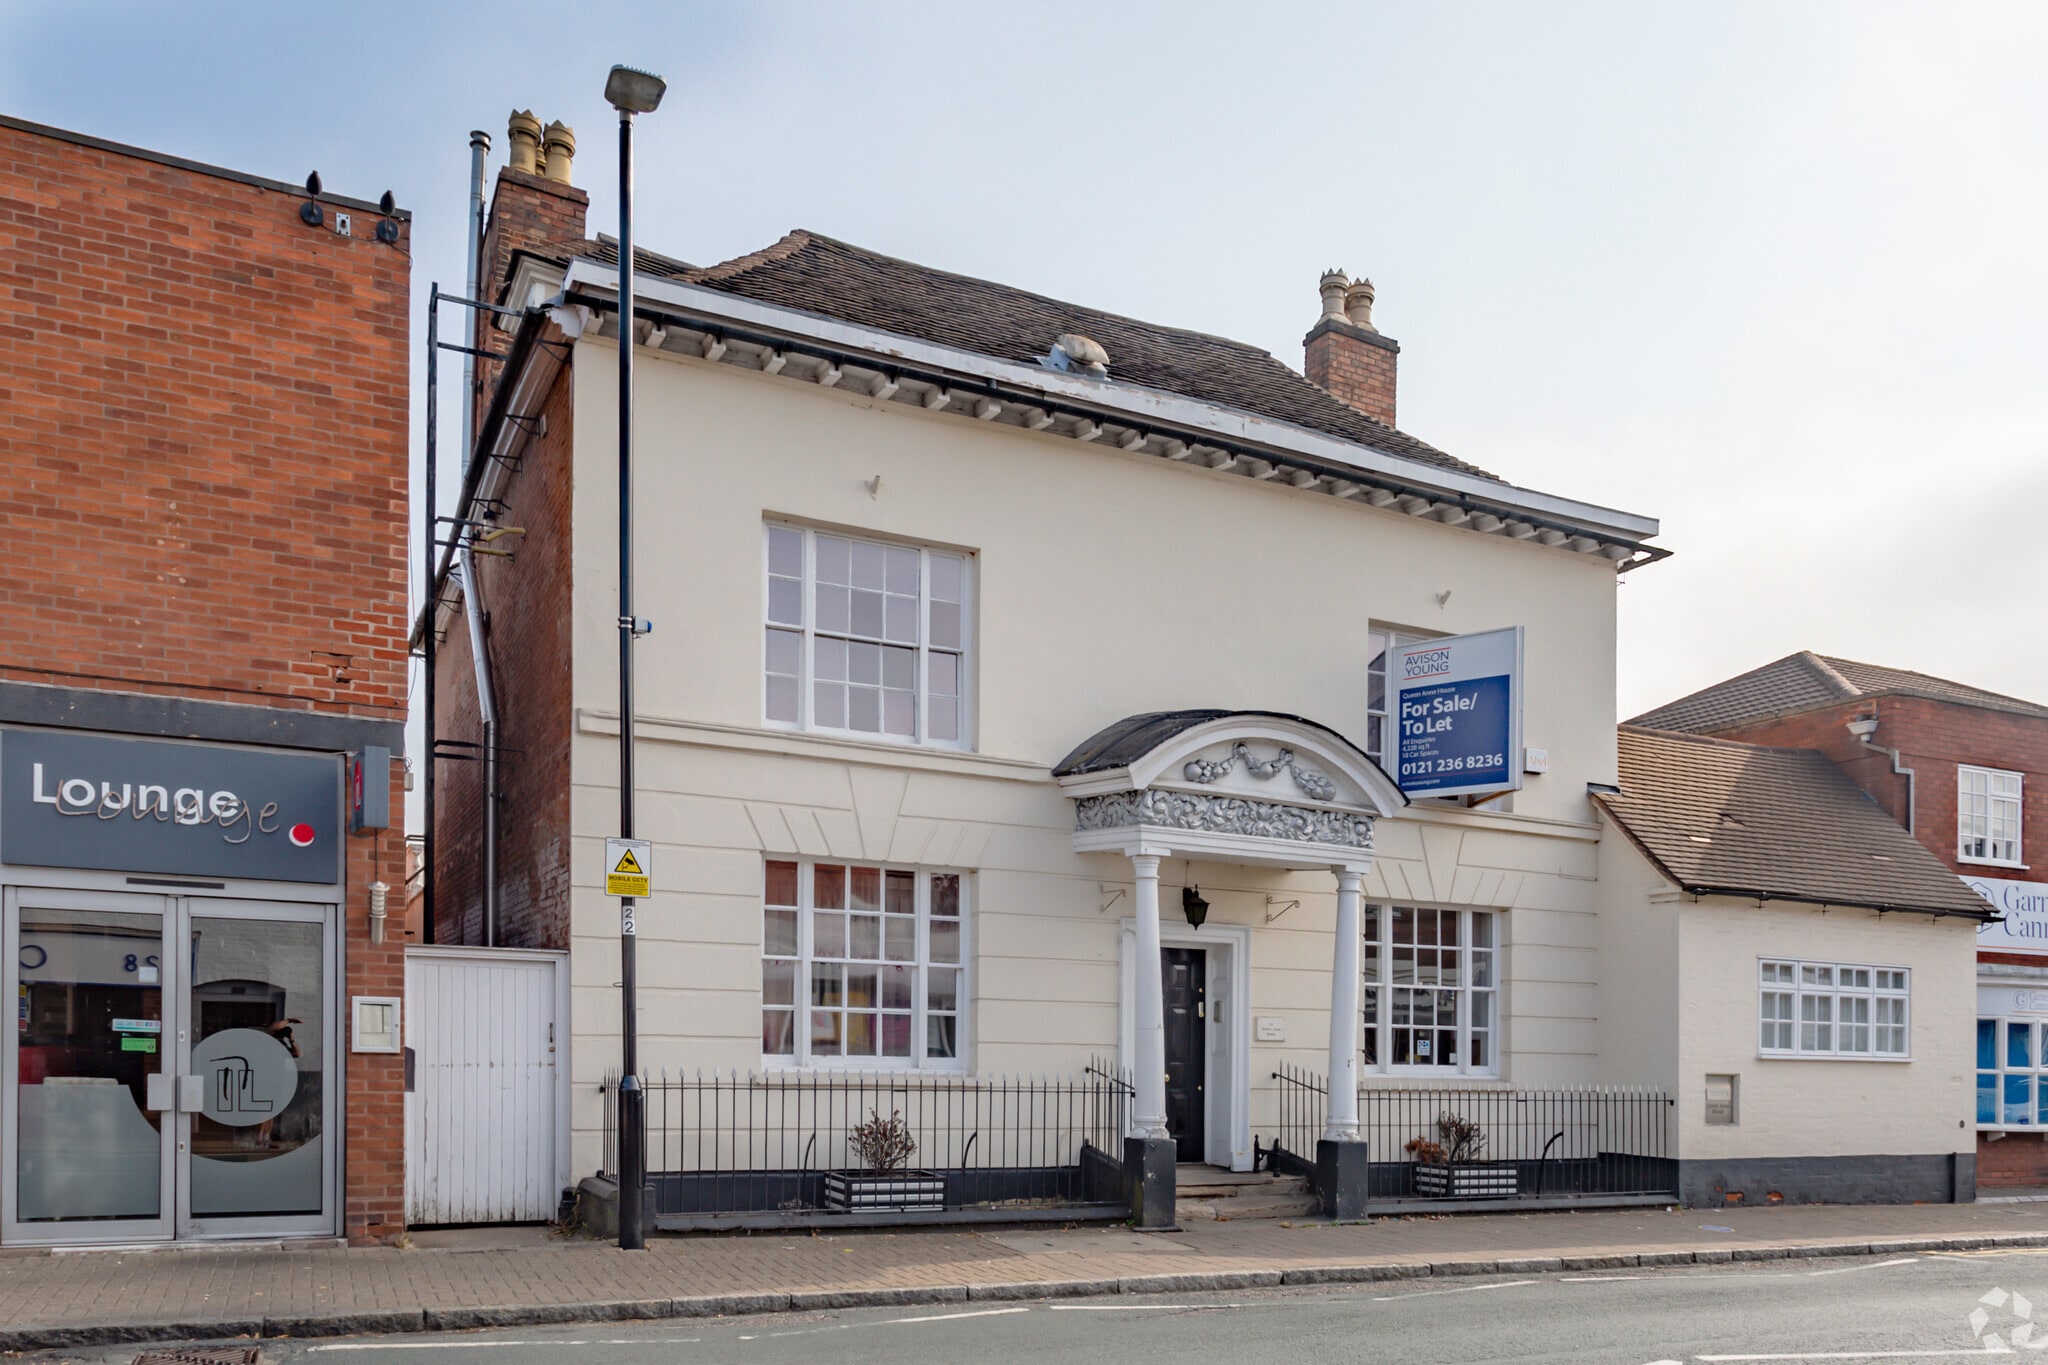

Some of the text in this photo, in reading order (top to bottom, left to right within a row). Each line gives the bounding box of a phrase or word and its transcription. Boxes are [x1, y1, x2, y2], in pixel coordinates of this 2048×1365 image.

[1404, 650, 1450, 667] AVISON
[1404, 661, 1449, 677] YOUNG
[1402, 693, 1478, 718] For Sale/
[1402, 716, 1453, 736] To Let
[1402, 753, 1503, 776] 0121 236 8236
[33, 762, 240, 826] Lounge
